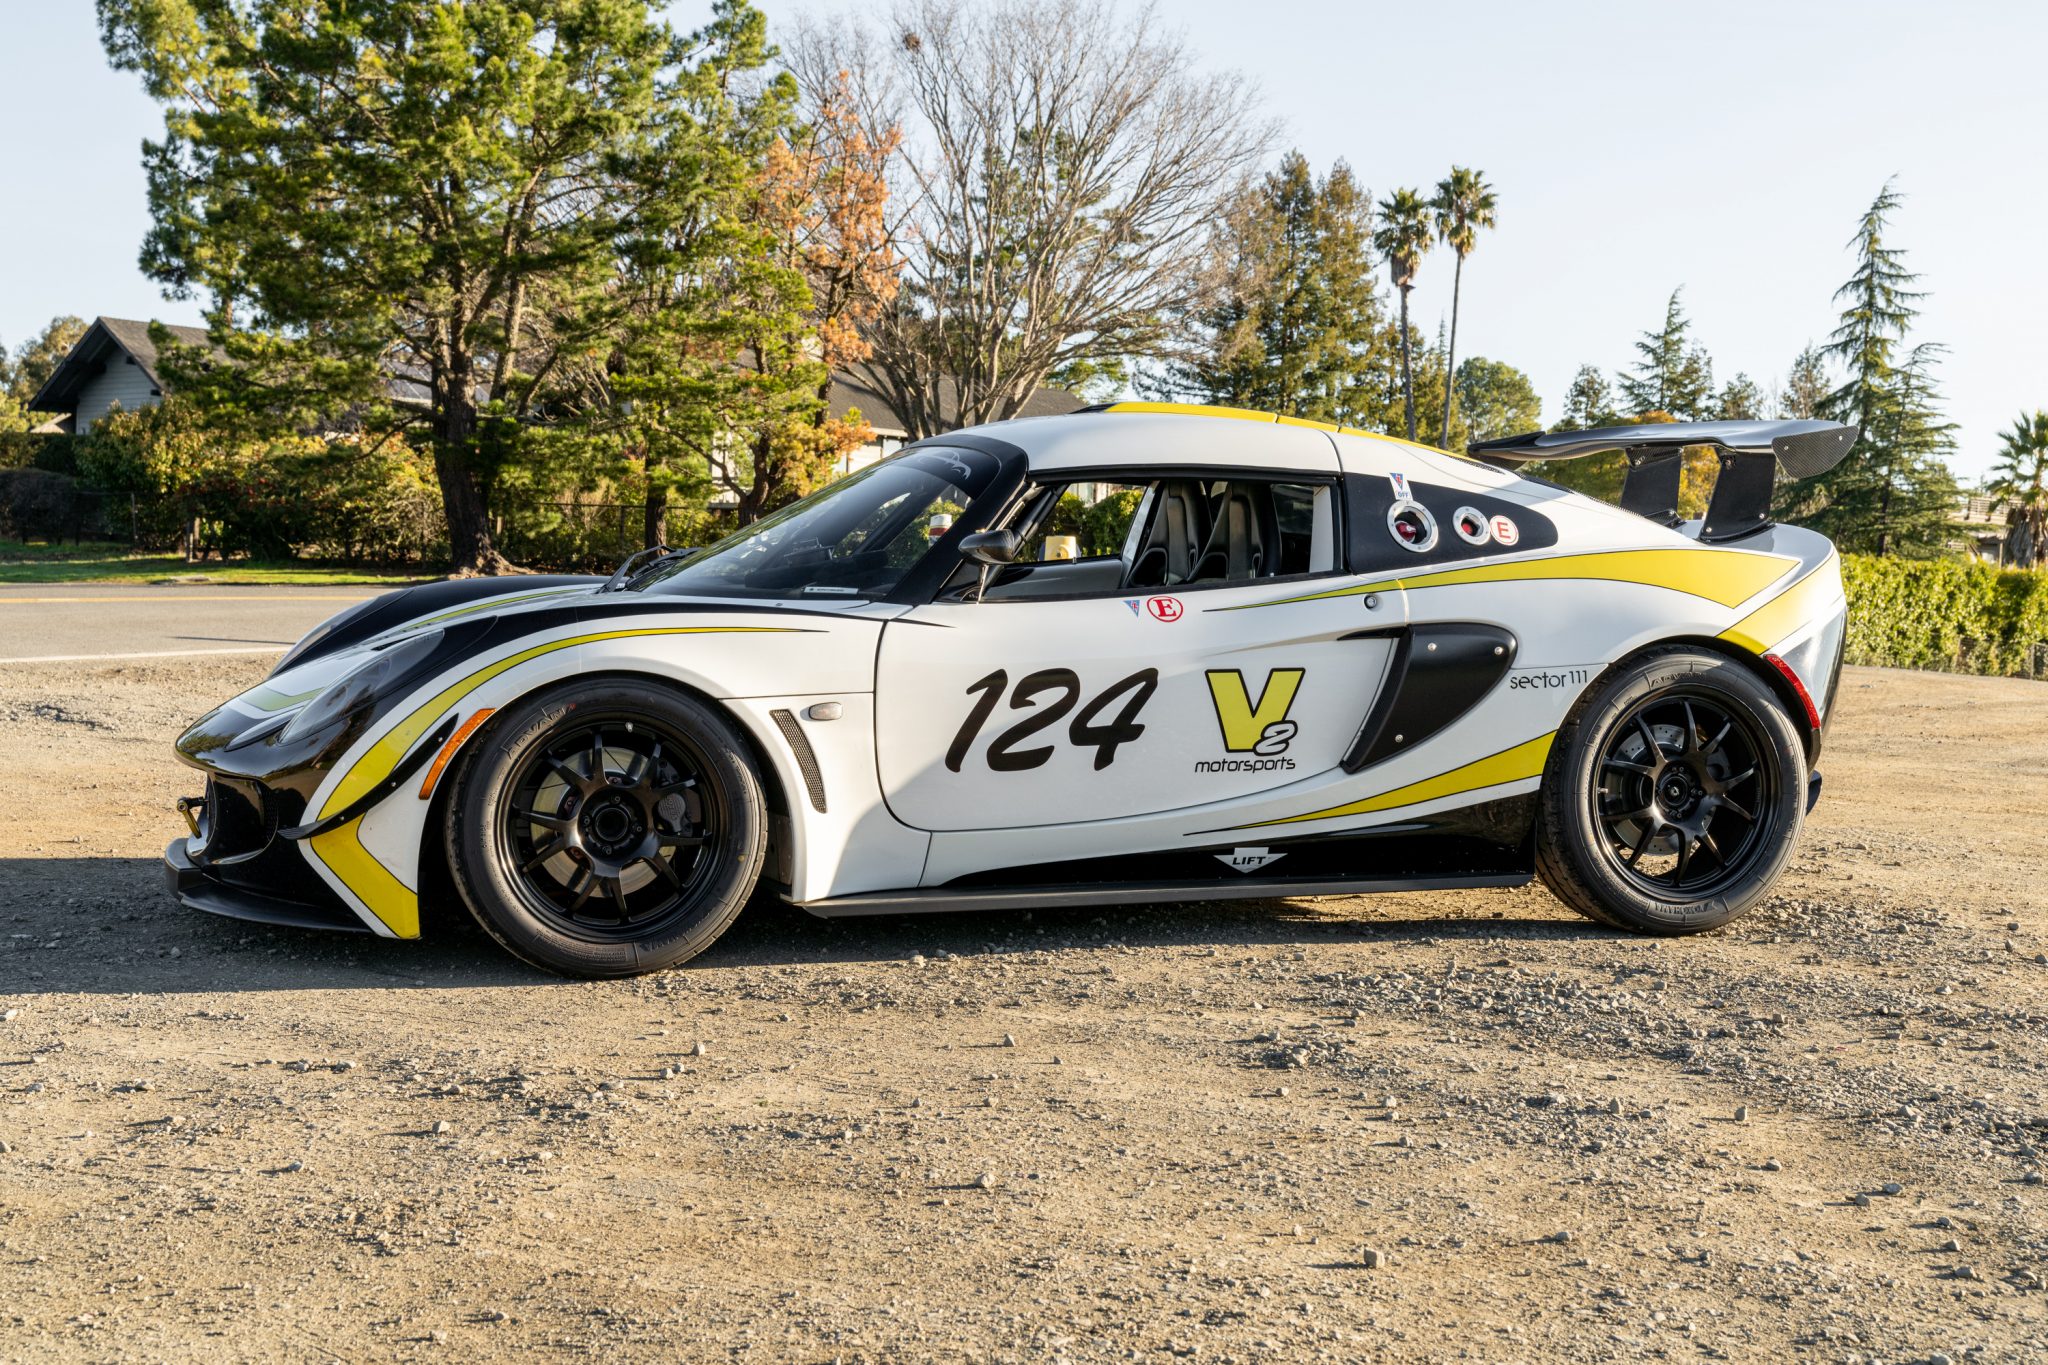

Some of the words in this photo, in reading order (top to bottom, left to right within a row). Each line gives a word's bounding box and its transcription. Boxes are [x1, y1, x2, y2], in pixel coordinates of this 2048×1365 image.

[1497, 521, 1511, 539] E
[1153, 598, 1177, 617] E
[944, 667, 1159, 773] 124
[1194, 756, 1296, 773] motorsports
[1232, 856, 1266, 866] LIFT
